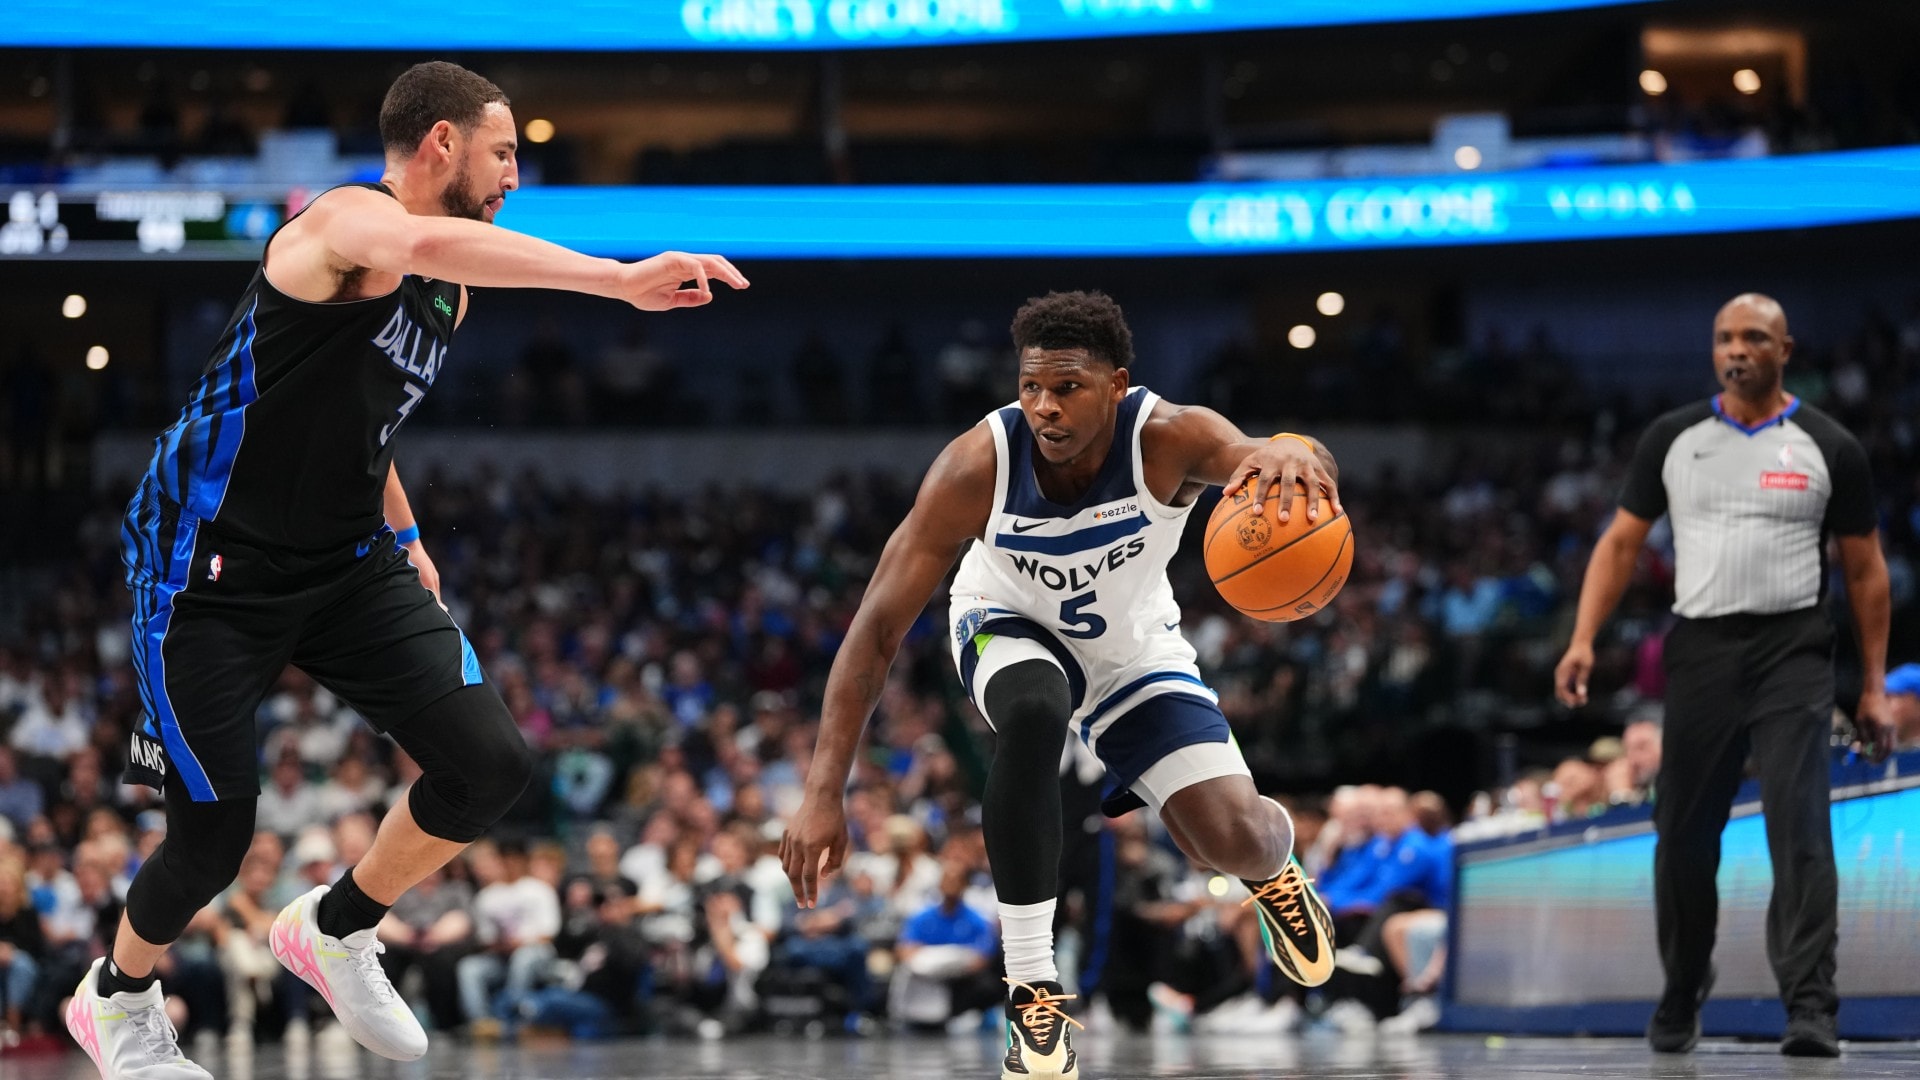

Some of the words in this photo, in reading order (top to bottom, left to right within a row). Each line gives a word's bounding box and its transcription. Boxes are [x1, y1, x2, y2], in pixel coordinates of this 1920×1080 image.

[1190, 192, 1314, 245] GREY
[1326, 184, 1508, 242] GOOSE
[1101, 503, 1138, 519] sezzle
[1006, 536, 1145, 592] WOLVES
[1058, 590, 1107, 639] 5
[131, 732, 165, 775] MAVS
